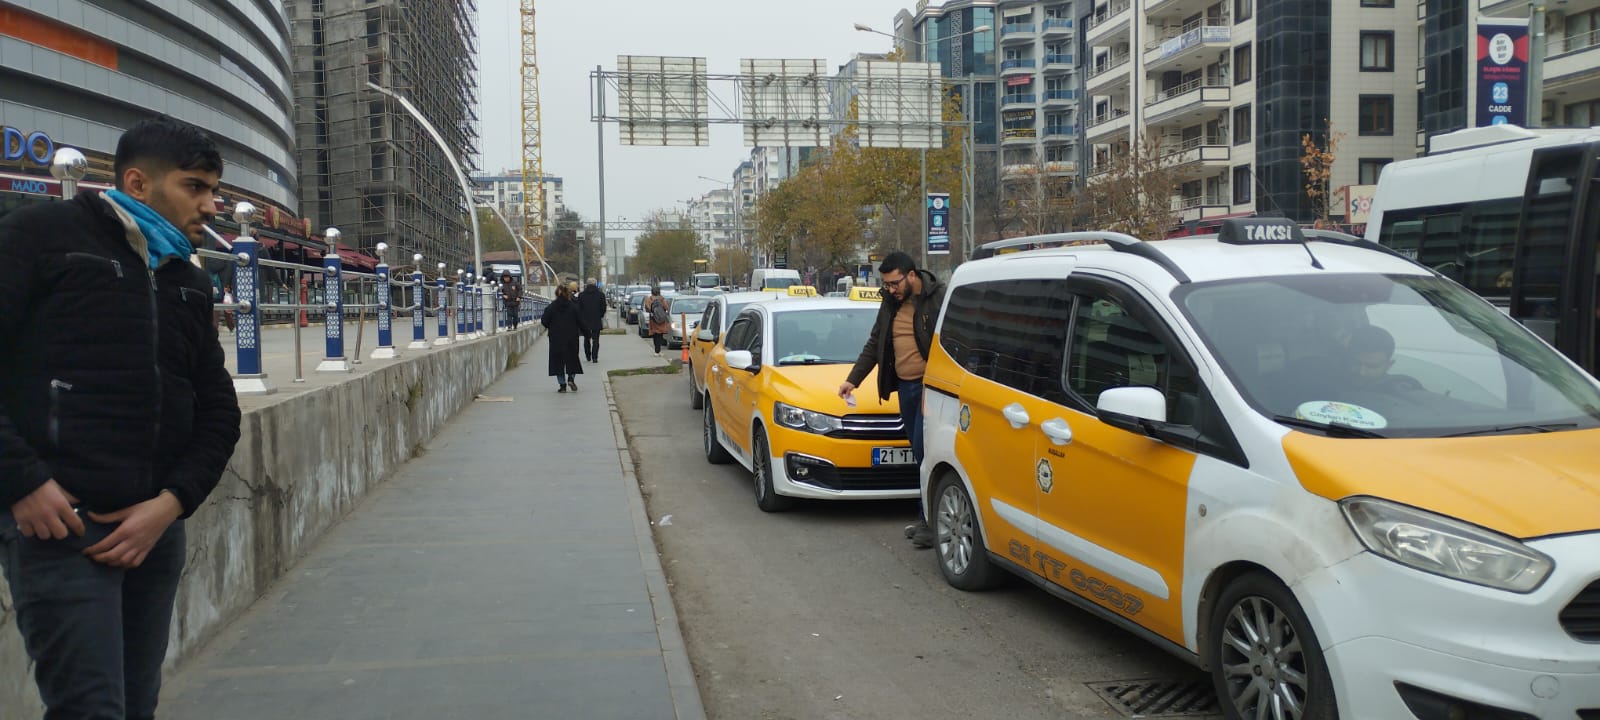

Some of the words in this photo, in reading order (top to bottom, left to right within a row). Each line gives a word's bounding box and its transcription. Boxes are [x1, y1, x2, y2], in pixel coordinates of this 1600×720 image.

[1493, 86, 1508, 99] 23
[1488, 105, 1512, 113] CADDE
[11, 180, 48, 194] MADO
[881, 450, 894, 463] 21
[1009, 539, 1030, 564] 21
[1033, 550, 1067, 578] TT
